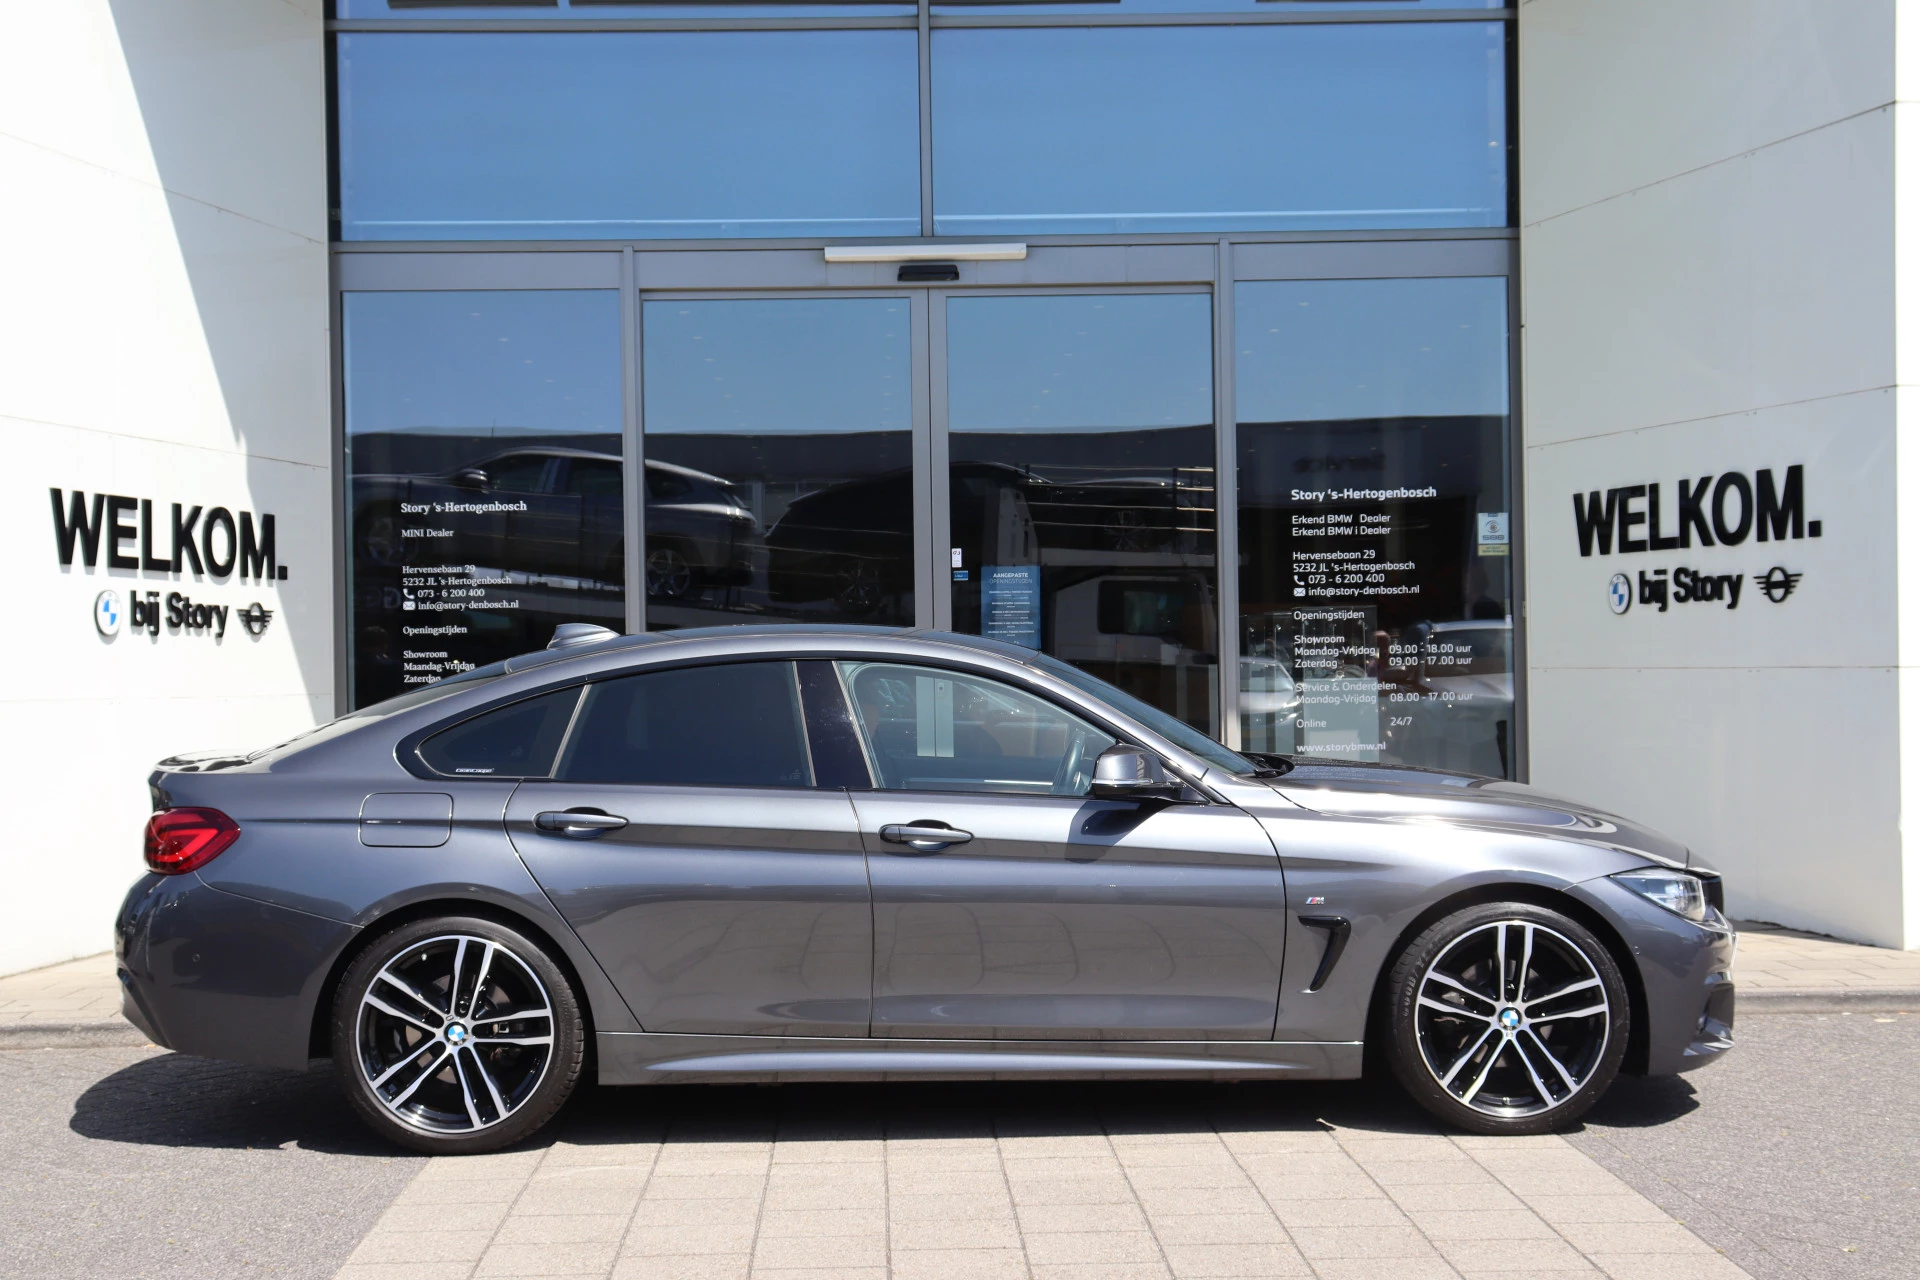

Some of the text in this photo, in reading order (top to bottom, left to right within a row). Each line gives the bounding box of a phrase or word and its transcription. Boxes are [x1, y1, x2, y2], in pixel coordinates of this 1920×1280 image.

[1291, 489, 1325, 501] Story
[400, 502, 430, 515] Story
[1573, 464, 1822, 557] WELKOM.
[1292, 513, 1391, 524] Erkend BMW Dealer
[49, 487, 288, 581] WELKOM.
[401, 528, 454, 538] MINI Dealer
[1292, 527, 1325, 536] Erkend
[1328, 526, 1353, 536] BMW
[1360, 526, 1391, 535] Dealer
[1293, 550, 1375, 560] Hervensebaan 29
[402, 564, 475, 574] Hervensebaan 29
[1293, 563, 1317, 572] 5232
[1318, 563, 1329, 572] JL
[402, 577, 425, 586] 5232
[426, 577, 437, 586] JL
[1308, 575, 1326, 584] 073
[1335, 574, 1342, 583] 6
[1344, 574, 1363, 583] 200
[1365, 573, 1385, 583] 400
[417, 589, 435, 598] 073
[441, 589, 448, 597] 6
[450, 589, 466, 597] 200
[468, 588, 485, 597] 400
[1308, 585, 1420, 597] info@story-denbosch.nl
[1638, 567, 1744, 612] bij Story
[418, 600, 519, 611] info@story-denbosch.nl
[130, 590, 229, 638] bij Story
[1293, 610, 1365, 621] Openingstijden
[403, 626, 468, 636] Openingstijden
[1294, 635, 1345, 644] Showroom
[403, 651, 448, 659] Showroom
[1294, 646, 1376, 657] Maandag-Vrijdag
[1389, 645, 1418, 654] 09.00
[1427, 644, 1454, 653] 18.00
[1456, 645, 1472, 653] uur
[1295, 659, 1338, 669] Zaterdag
[1389, 657, 1418, 666] 09.00
[1456, 657, 1472, 665] uur
[1295, 681, 1397, 692] Service & Onderdelen
[1296, 693, 1377, 705] Maandag-Vrijdag
[1390, 692, 1420, 702] 08.00
[1457, 692, 1474, 700] uur
[1296, 717, 1412, 728] Online 24/7
[1296, 742, 1386, 753] www.storybmw.nl
